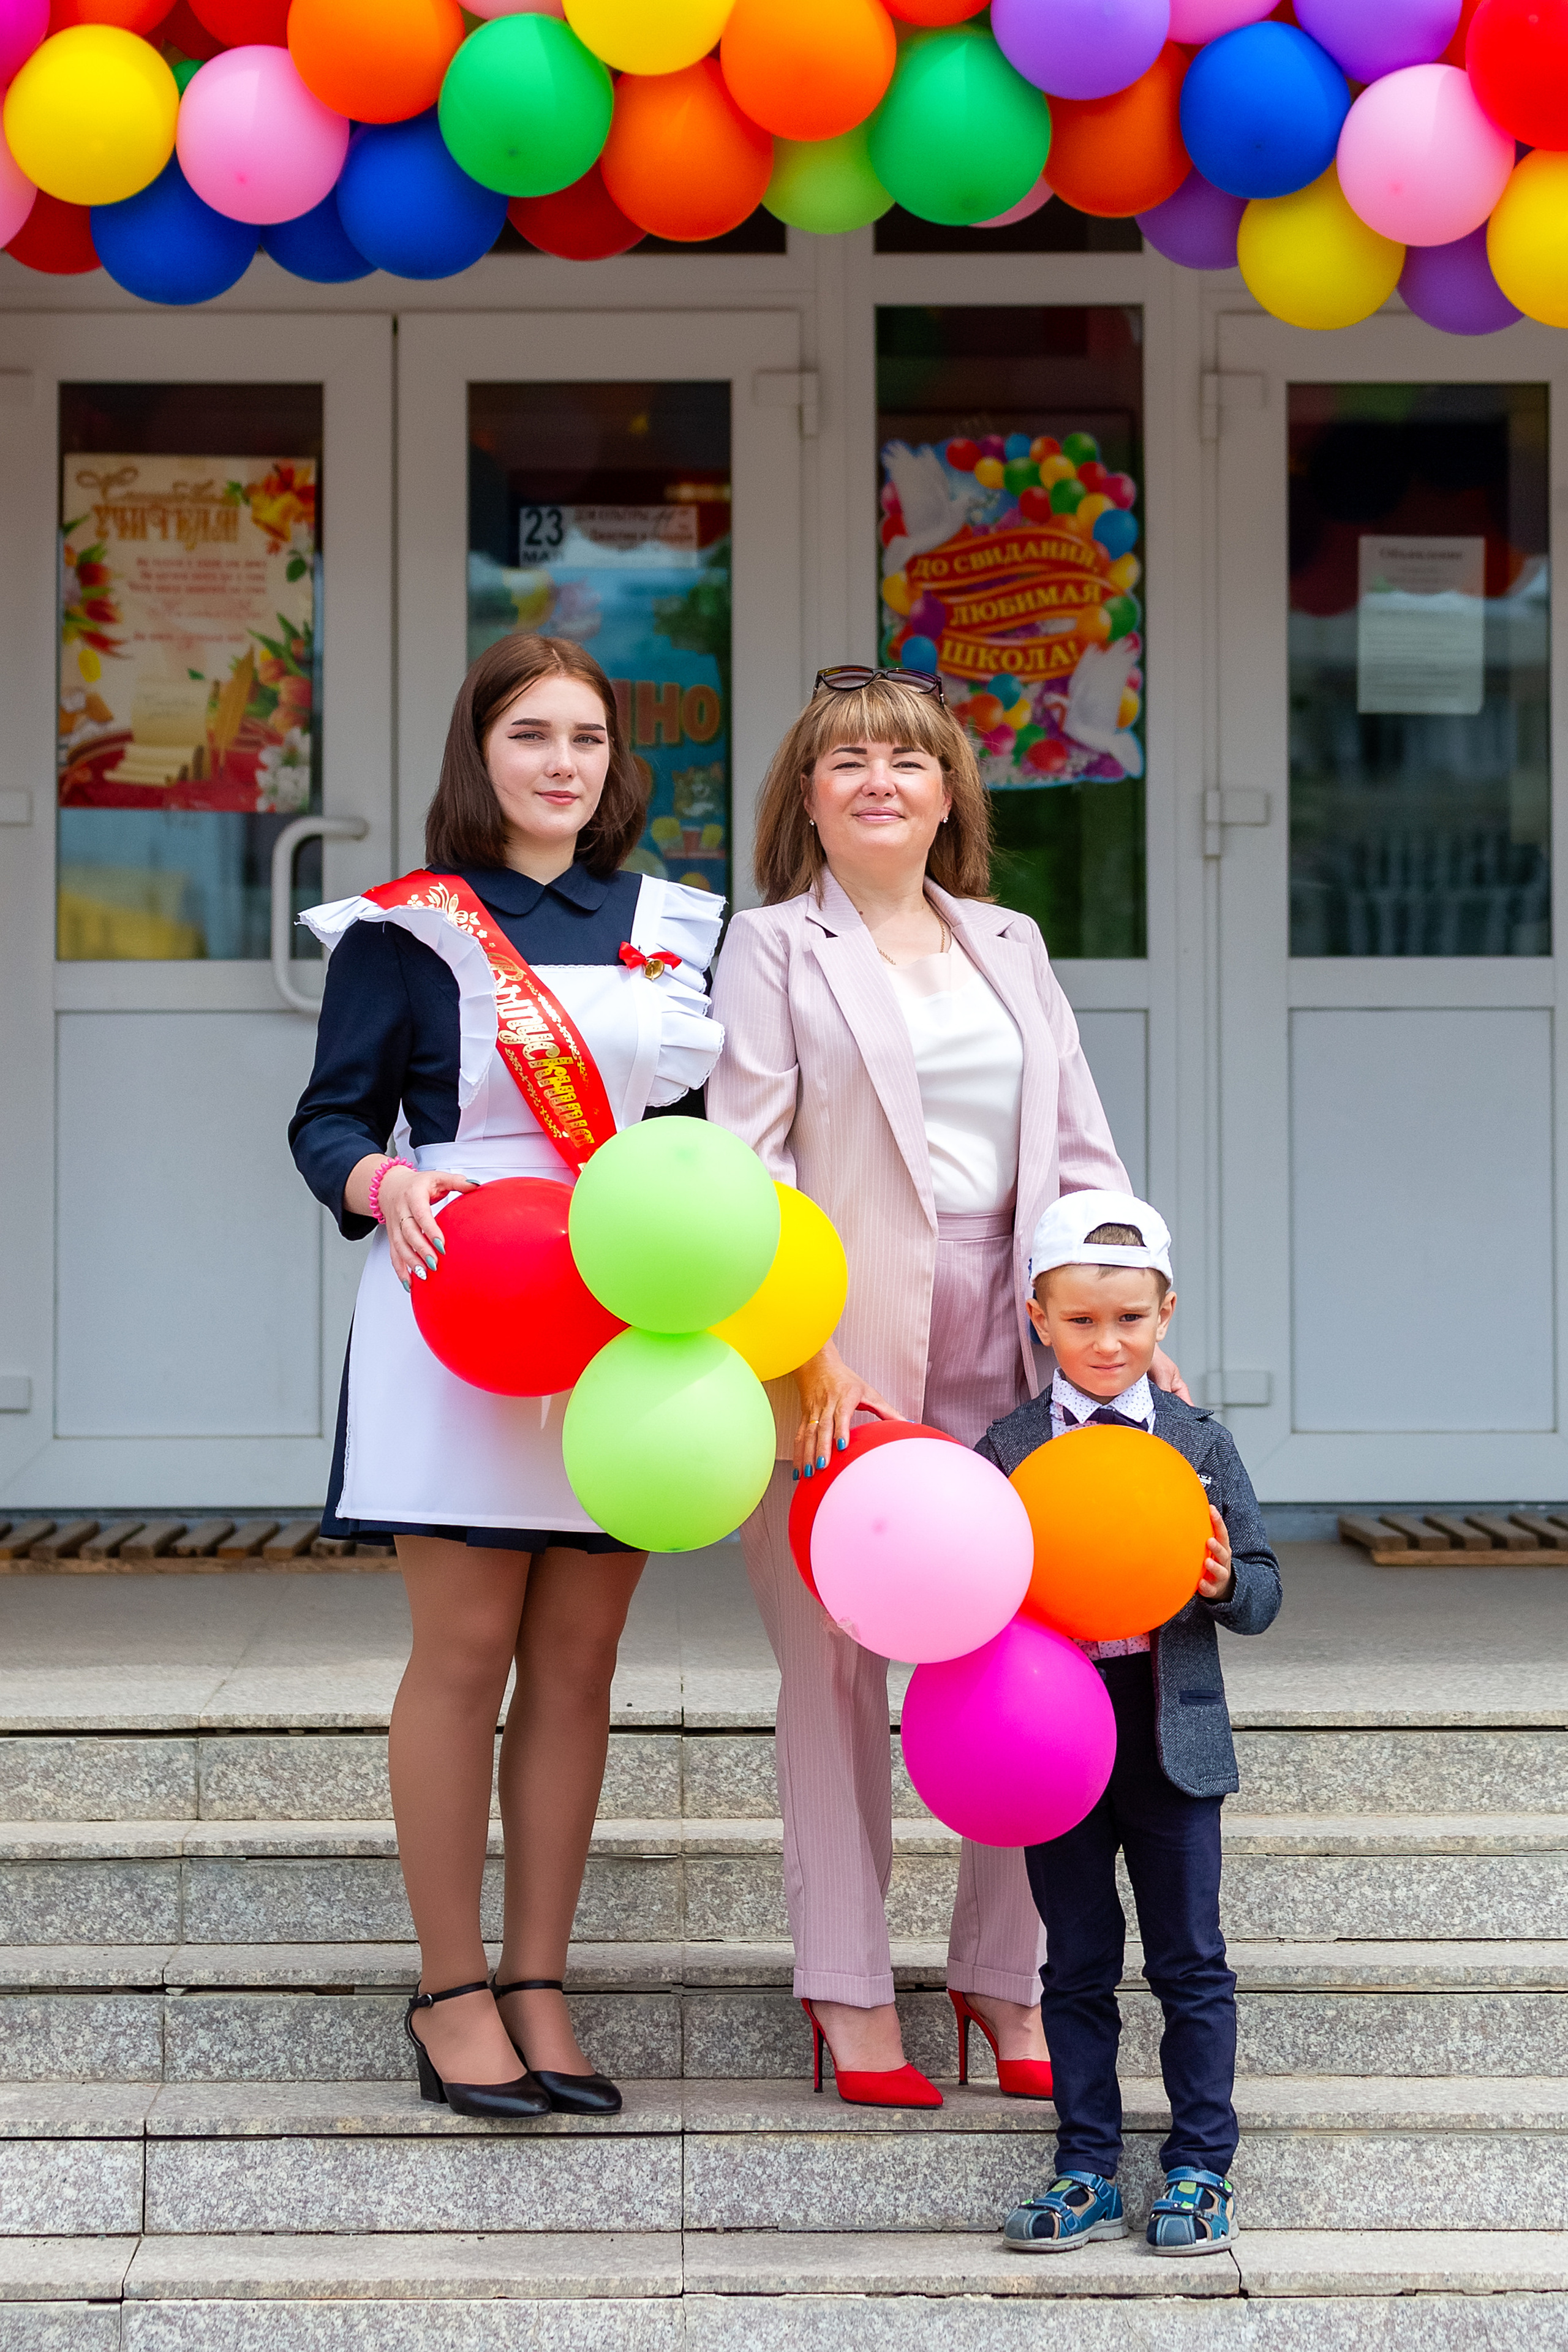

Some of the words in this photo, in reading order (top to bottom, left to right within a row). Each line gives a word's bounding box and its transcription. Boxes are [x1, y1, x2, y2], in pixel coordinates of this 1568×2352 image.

[526, 508, 563, 545] 23
[913, 557, 948, 578] ДО
[951, 584, 1099, 625] ЛЮБИМАЯ
[943, 640, 1077, 671] ШКОЛА!
